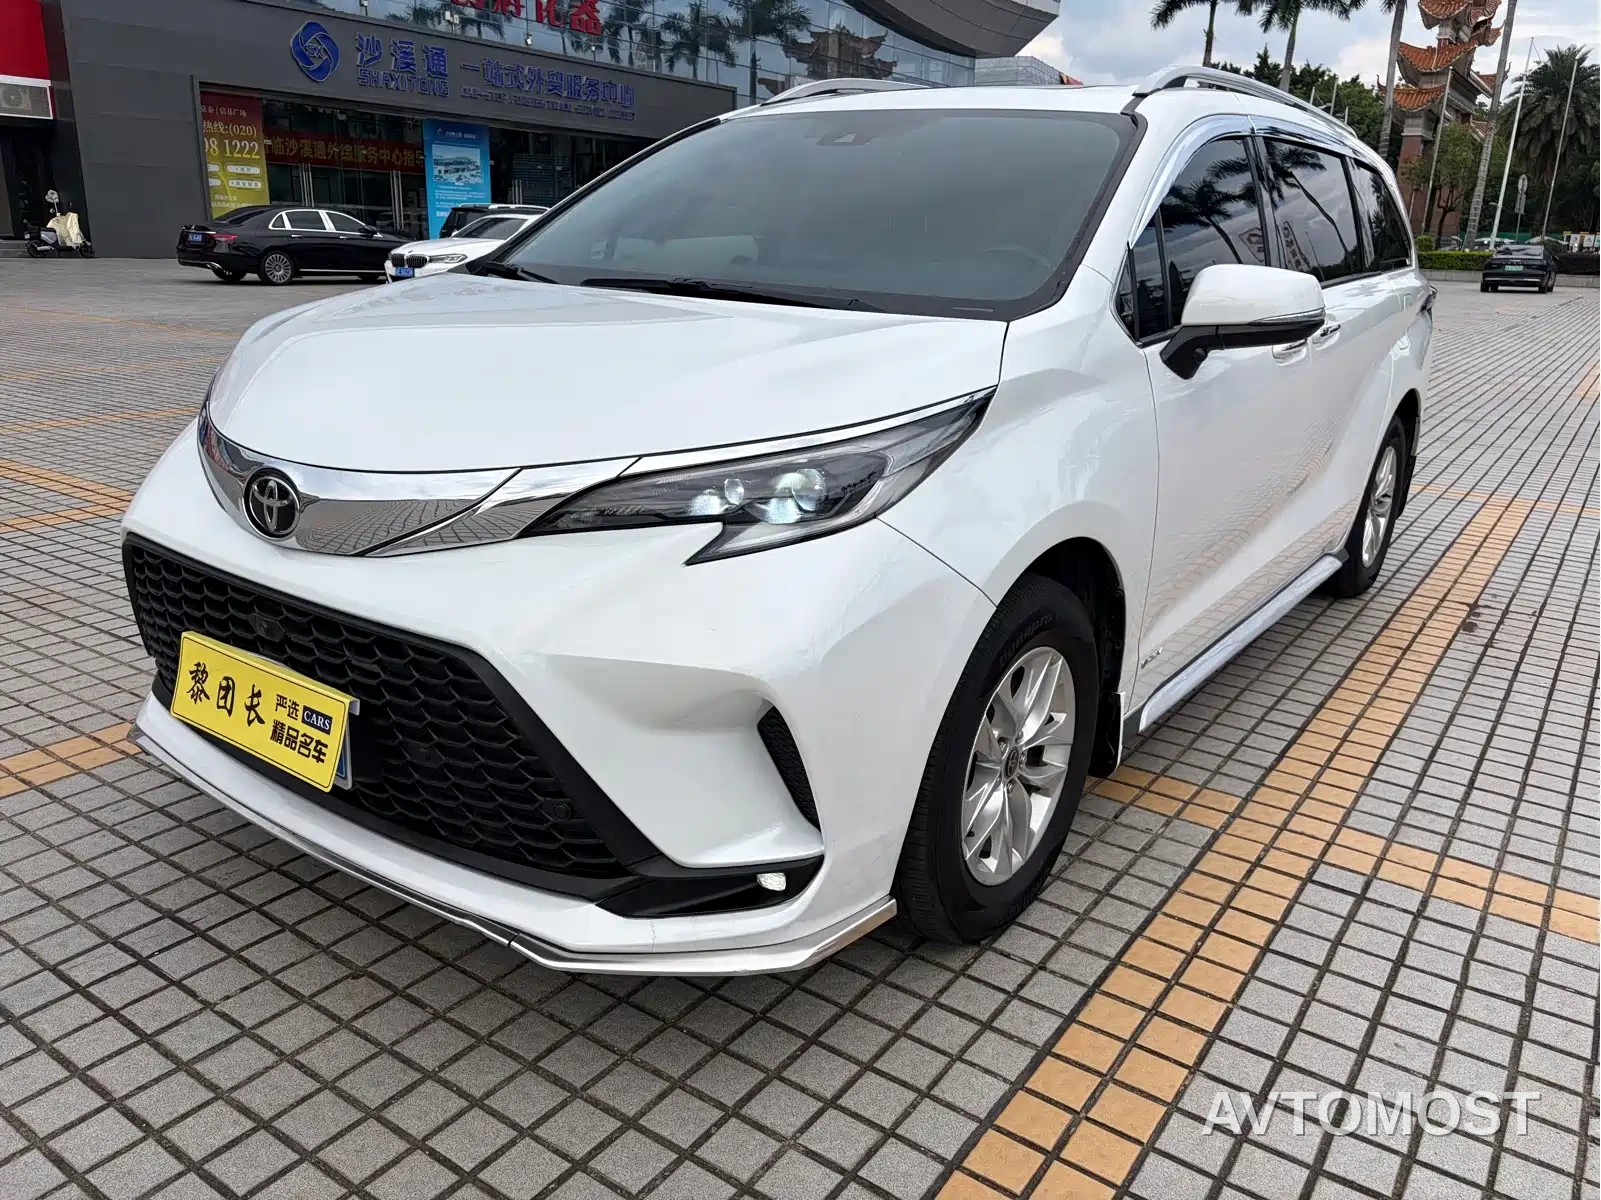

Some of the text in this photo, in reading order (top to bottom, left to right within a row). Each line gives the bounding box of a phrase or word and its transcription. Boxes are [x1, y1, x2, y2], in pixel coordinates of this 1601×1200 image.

[305, 43, 324, 58] SX
[355, 32, 448, 79] 沙溪通
[356, 68, 450, 97] SHAXITONG
[459, 57, 637, 107] 一站式外贸服务中心
[223, 139, 260, 159] 1222
[186, 661, 266, 727] 黎团长
[274, 693, 331, 731] 严选 CARS
[269, 719, 329, 764] 精品名车
